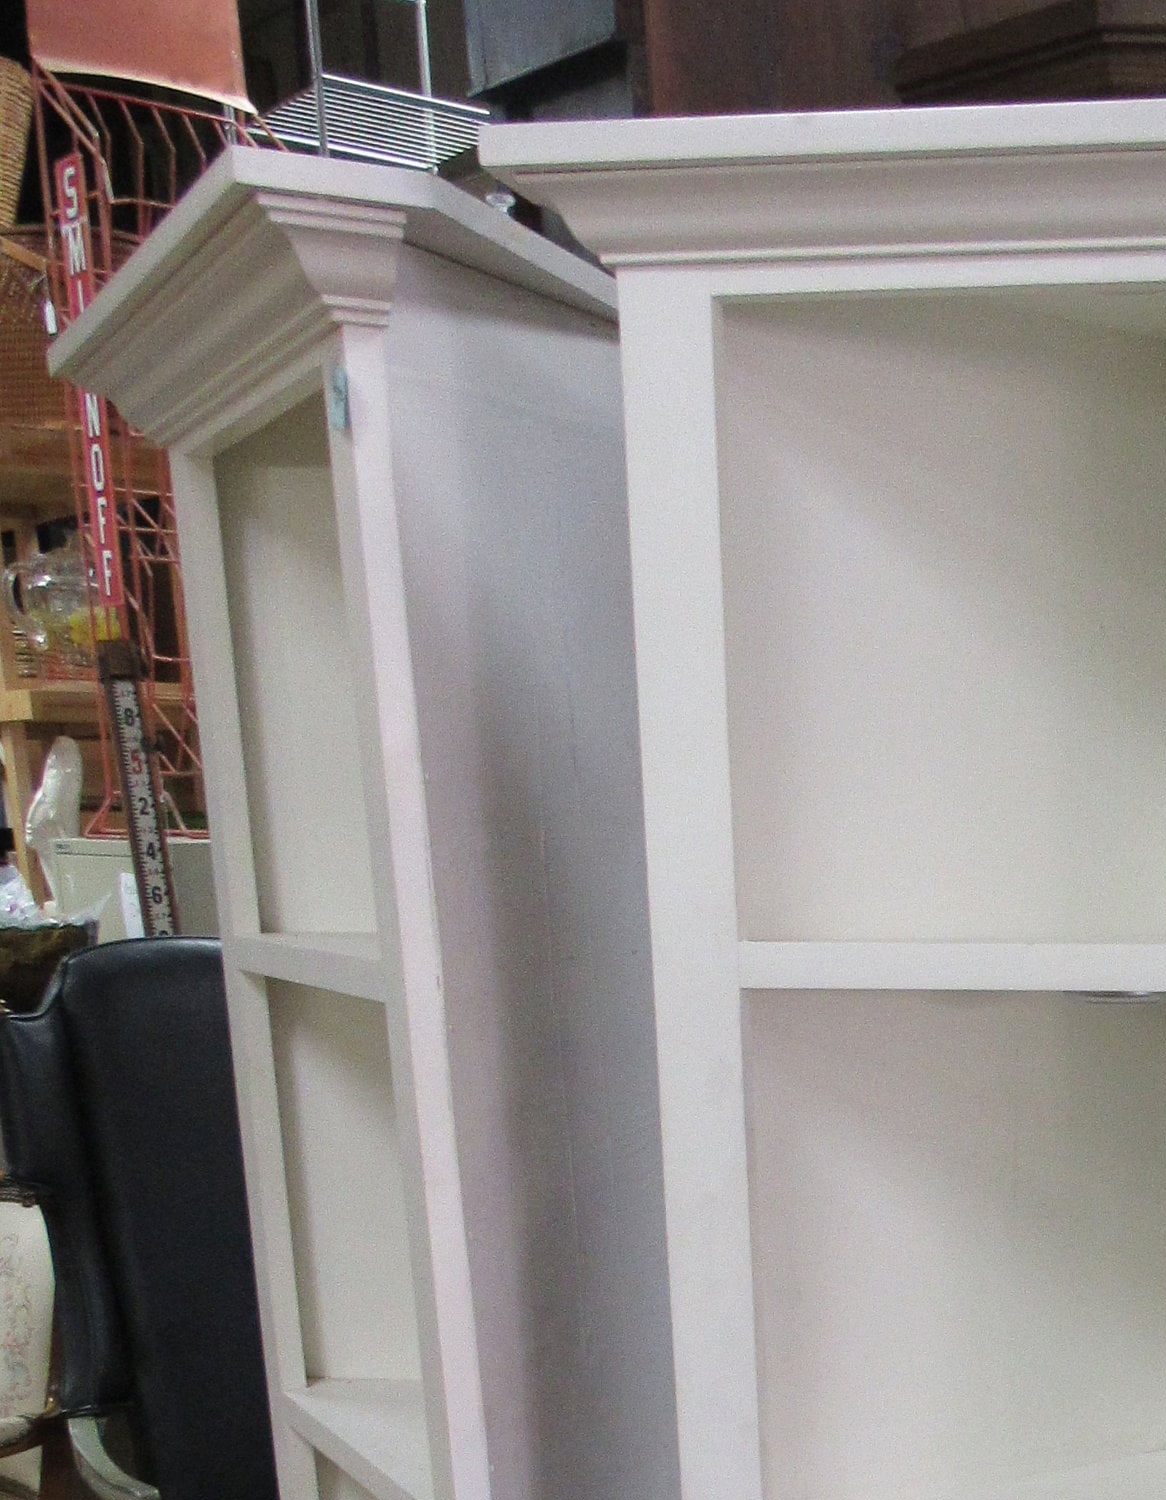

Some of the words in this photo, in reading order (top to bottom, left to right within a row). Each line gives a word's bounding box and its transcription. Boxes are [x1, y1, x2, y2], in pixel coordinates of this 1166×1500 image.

[62, 166, 113, 597] SMINOFF
[130, 748, 143, 775] 5
[138, 797, 151, 817] 2
[146, 842, 157, 861] 4
[152, 885, 164, 905] 6
